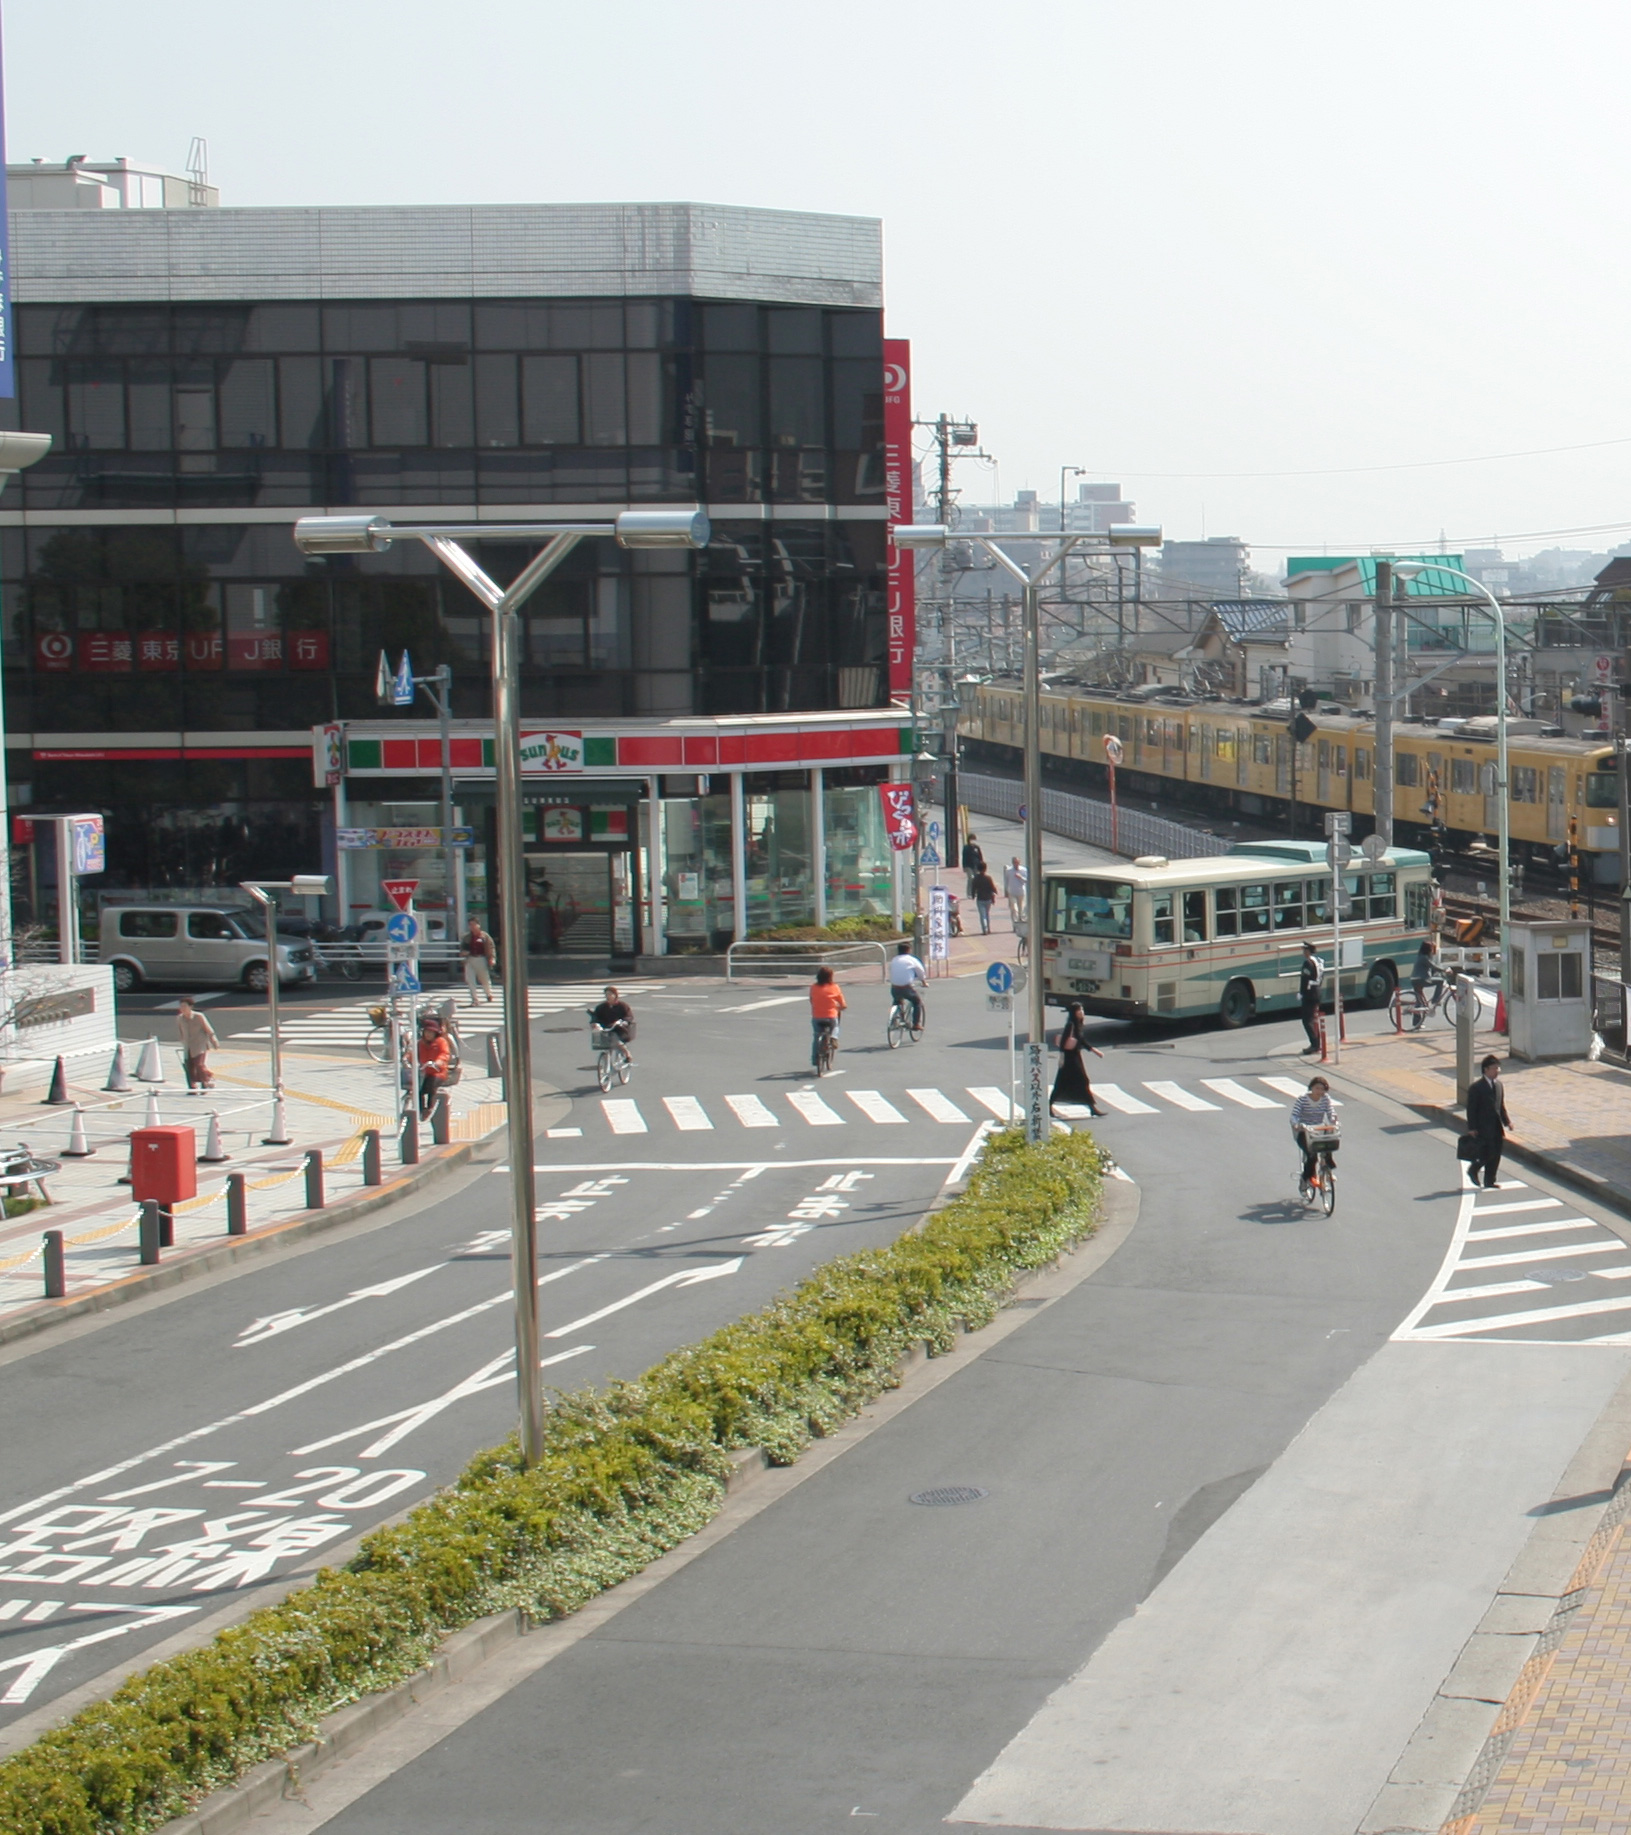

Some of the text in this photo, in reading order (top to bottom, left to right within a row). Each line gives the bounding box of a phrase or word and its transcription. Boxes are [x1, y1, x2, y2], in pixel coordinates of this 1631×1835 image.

[91, 640, 317, 662] 三菱東京UFJ銀行
[390, 886, 413, 895] 止まれ
[740, 1170, 875, 1247] 止まれ
[96, 1461, 427, 1510] 7-20
[0, 1504, 353, 1591] 路線
